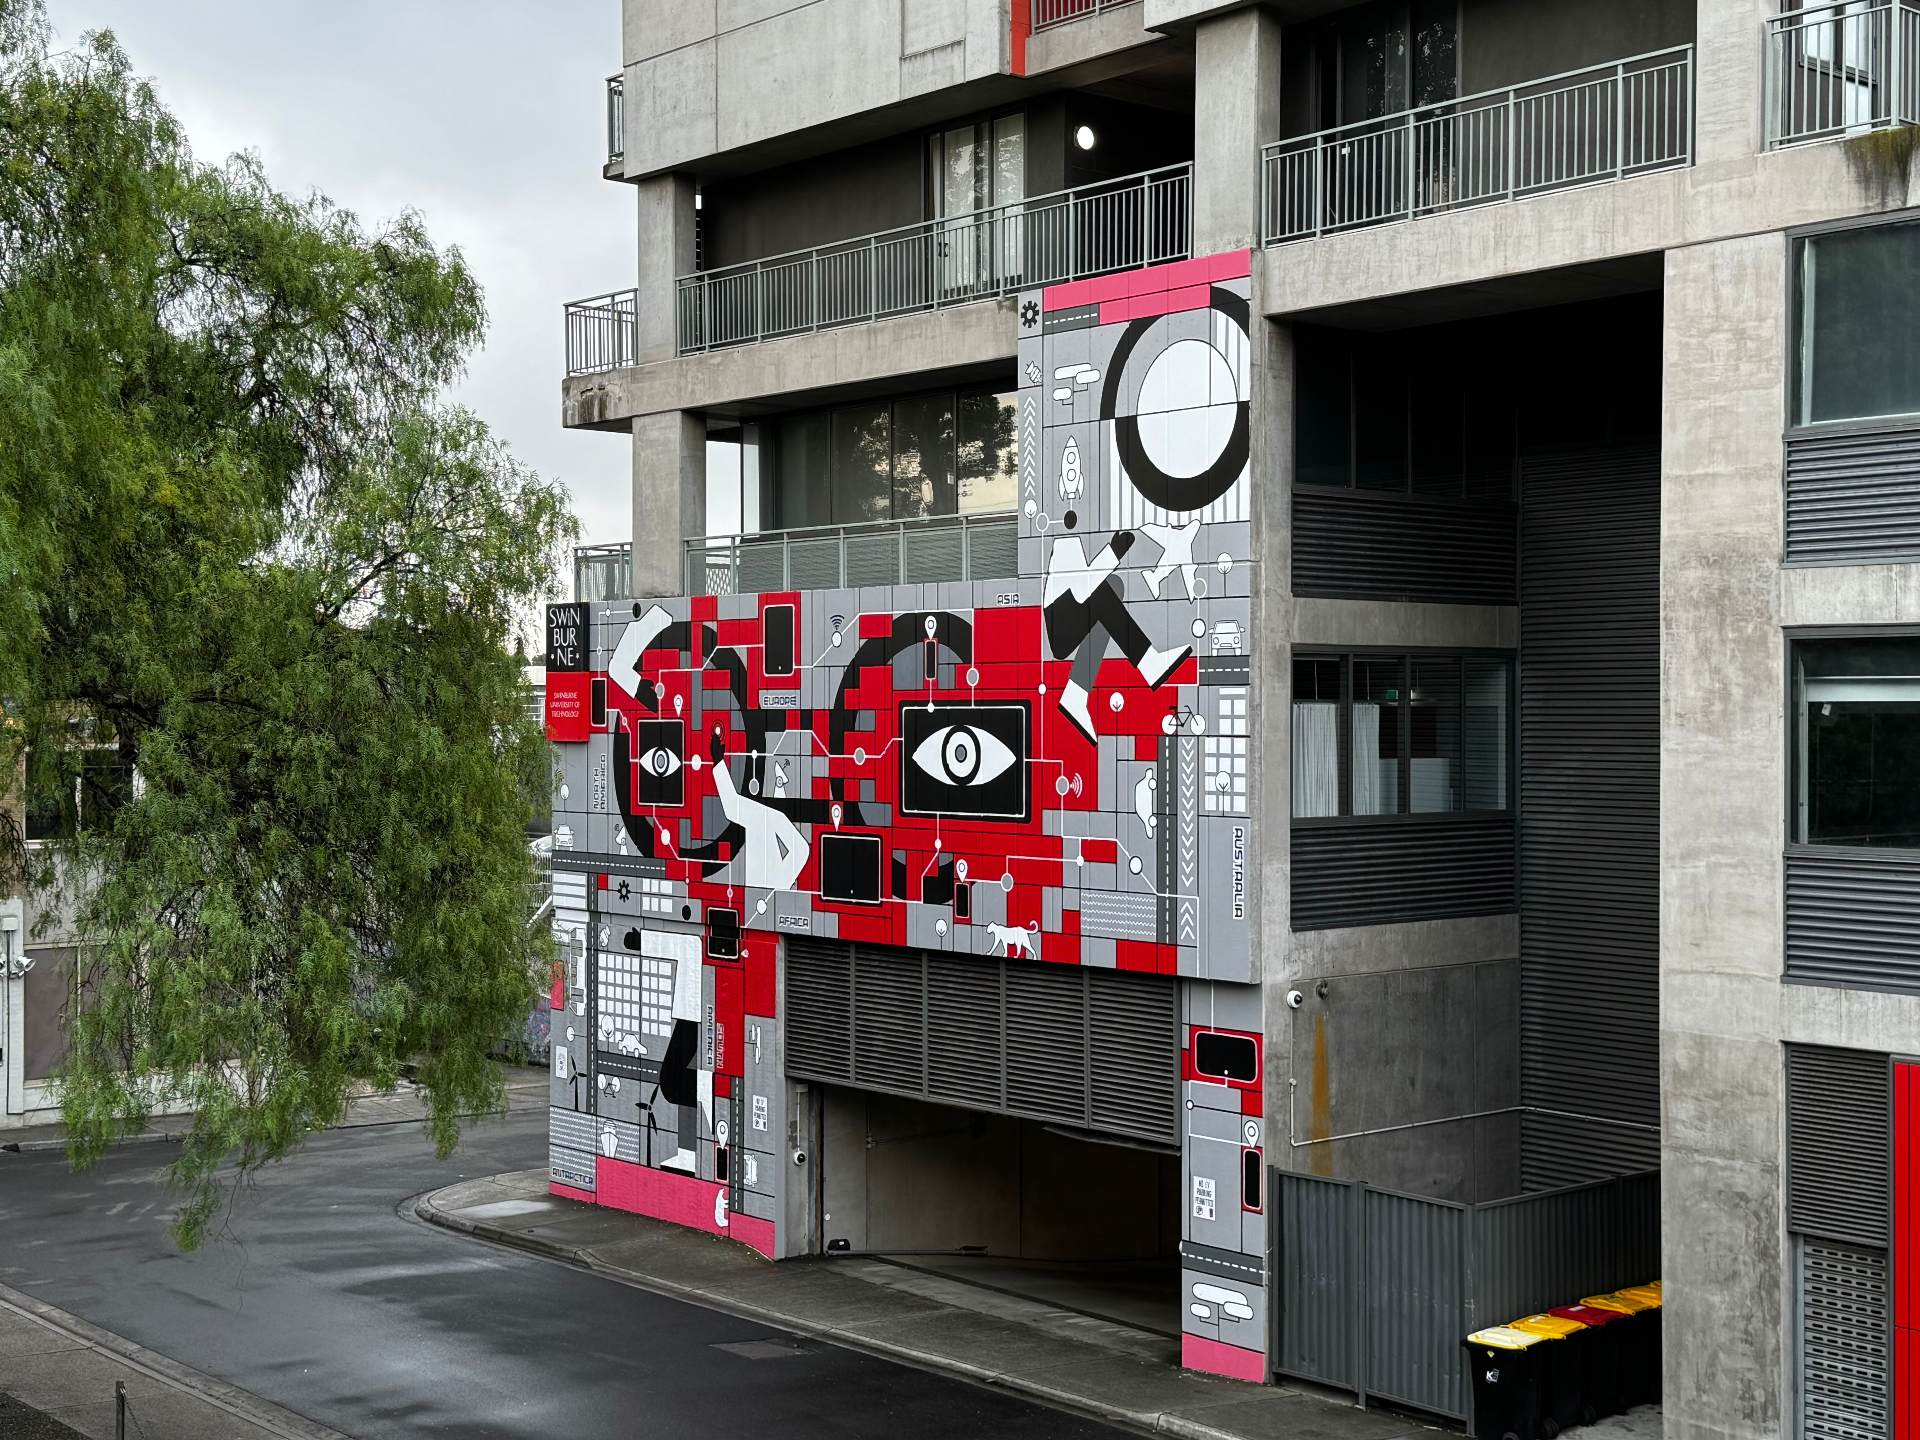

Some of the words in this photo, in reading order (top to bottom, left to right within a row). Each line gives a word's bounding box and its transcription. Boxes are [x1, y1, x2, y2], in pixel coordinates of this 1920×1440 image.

[997, 594, 1019, 605] ASIA
[553, 628, 577, 646] BUR
[763, 696, 797, 706] EUROPE
[1234, 827, 1243, 918] AUSTRALIA
[779, 915, 809, 929] AFRICA
